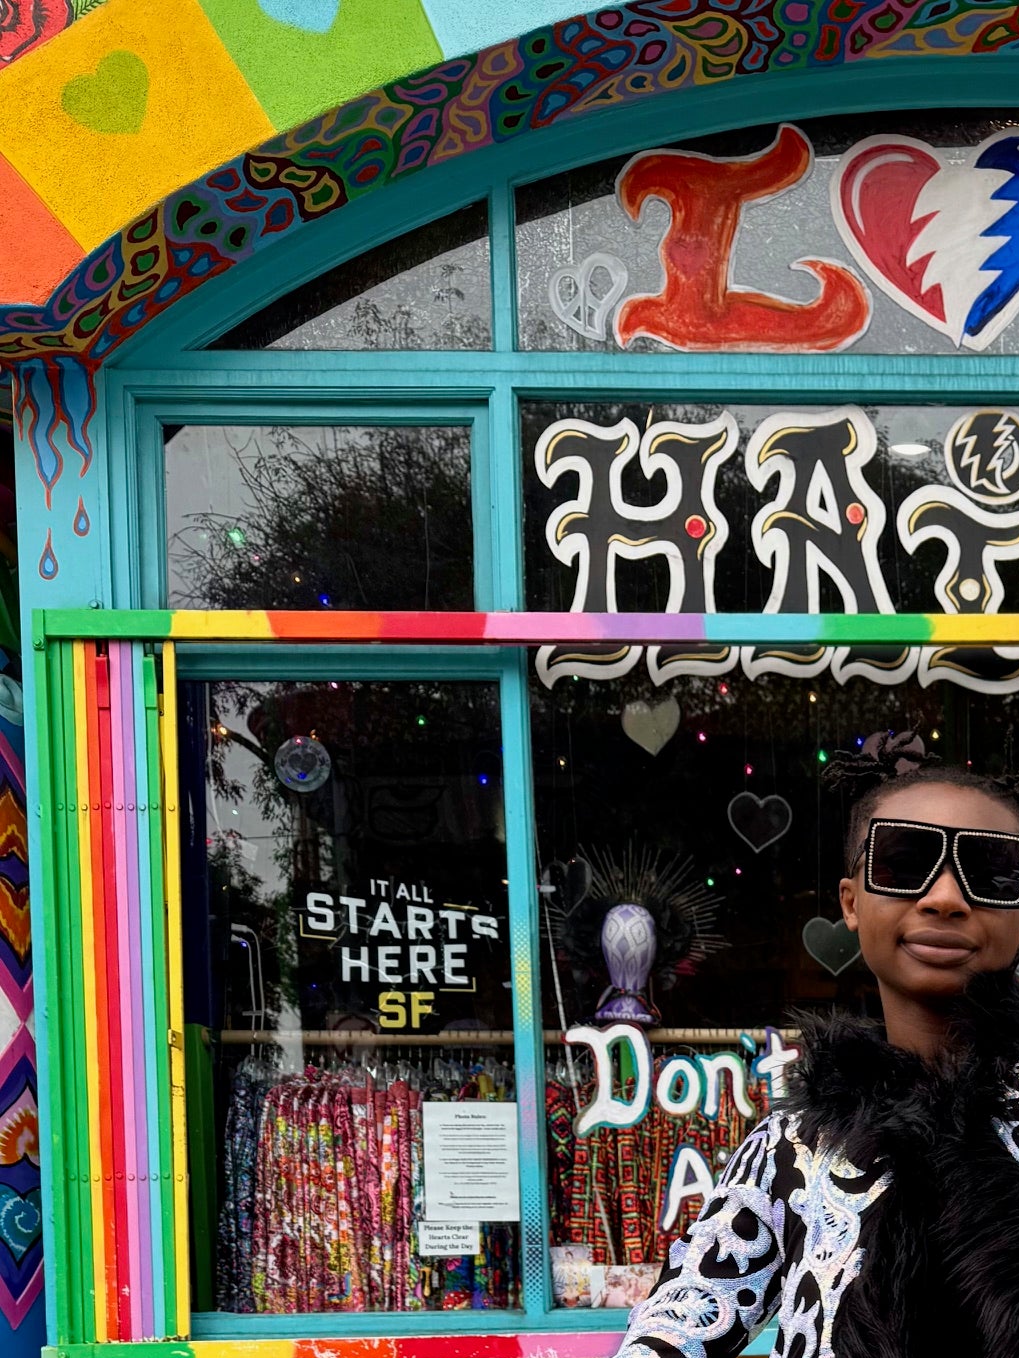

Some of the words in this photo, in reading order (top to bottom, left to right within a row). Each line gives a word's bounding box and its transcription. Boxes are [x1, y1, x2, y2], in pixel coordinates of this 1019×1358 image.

[369, 878, 390, 897] IT
[395, 882, 434, 904] ALL
[306, 892, 499, 940] STARTS
[341, 944, 470, 984] HERE
[377, 990, 436, 1029] SF
[561, 1020, 803, 1138] Don't
[425, 1243, 448, 1251] During
[461, 1243, 473, 1251] Day
[445, 1224, 461, 1232] Keep
